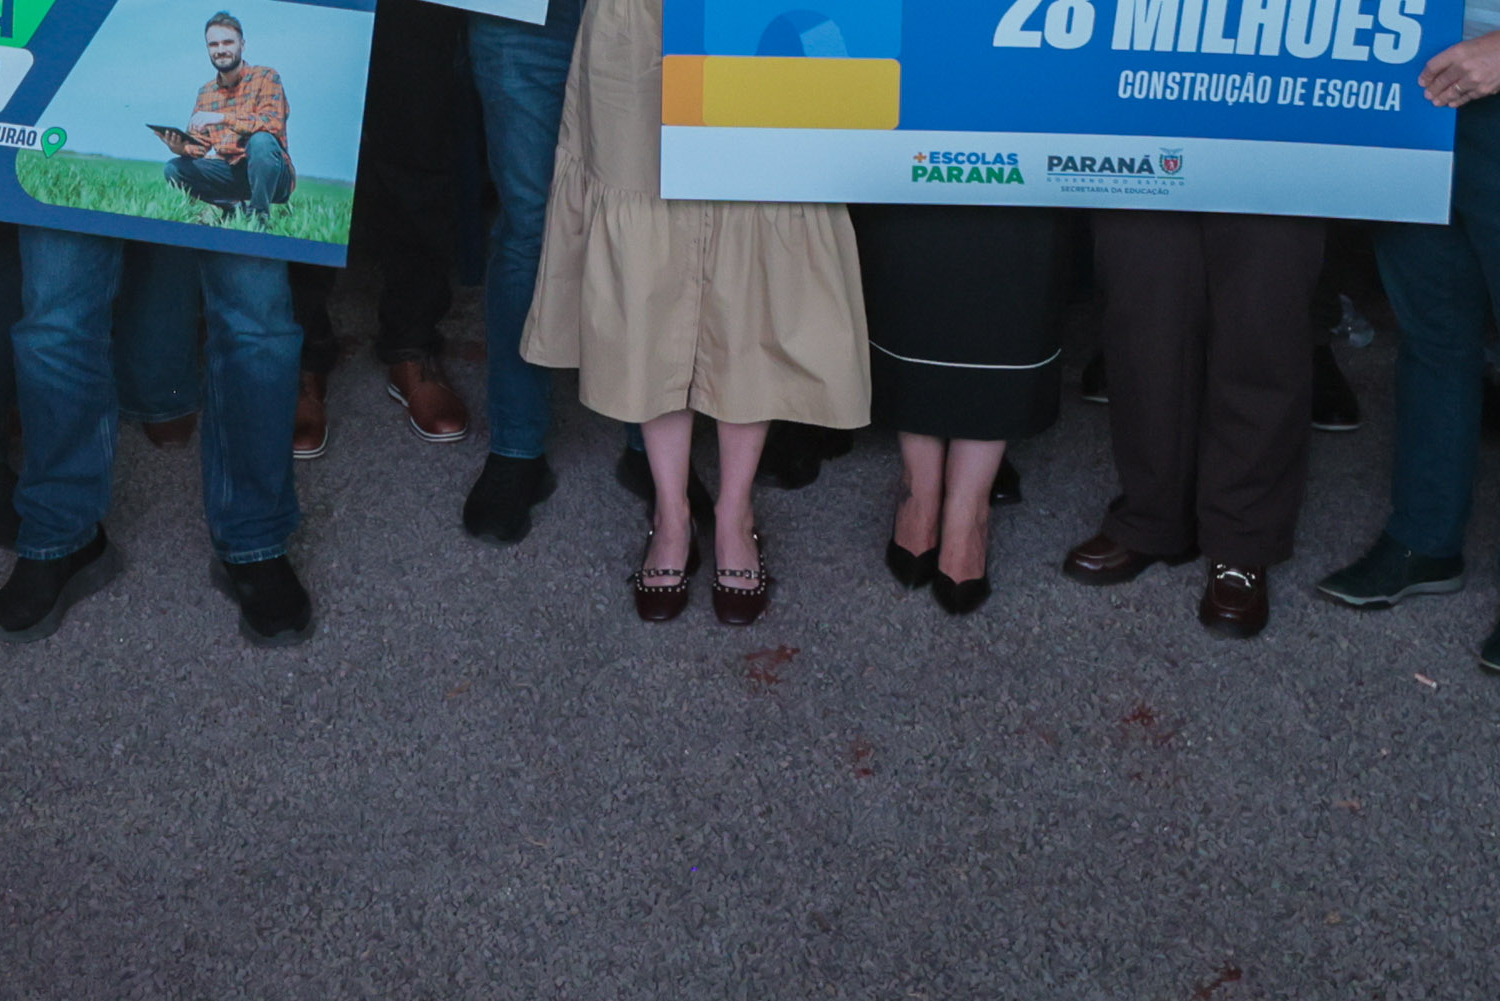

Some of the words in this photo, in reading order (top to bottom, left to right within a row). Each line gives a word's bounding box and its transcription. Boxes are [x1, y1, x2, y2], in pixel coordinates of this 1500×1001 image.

[1118, 69, 1273, 106] CONSTRUÇÃO
[1277, 77, 1308, 105] DE
[1312, 79, 1400, 111] ESCOLA
[1047, 154, 1155, 175] PARANÁ
[911, 165, 1025, 185] PARANÁ
[1124, 186, 1170, 195] EDUCAÇÃO
